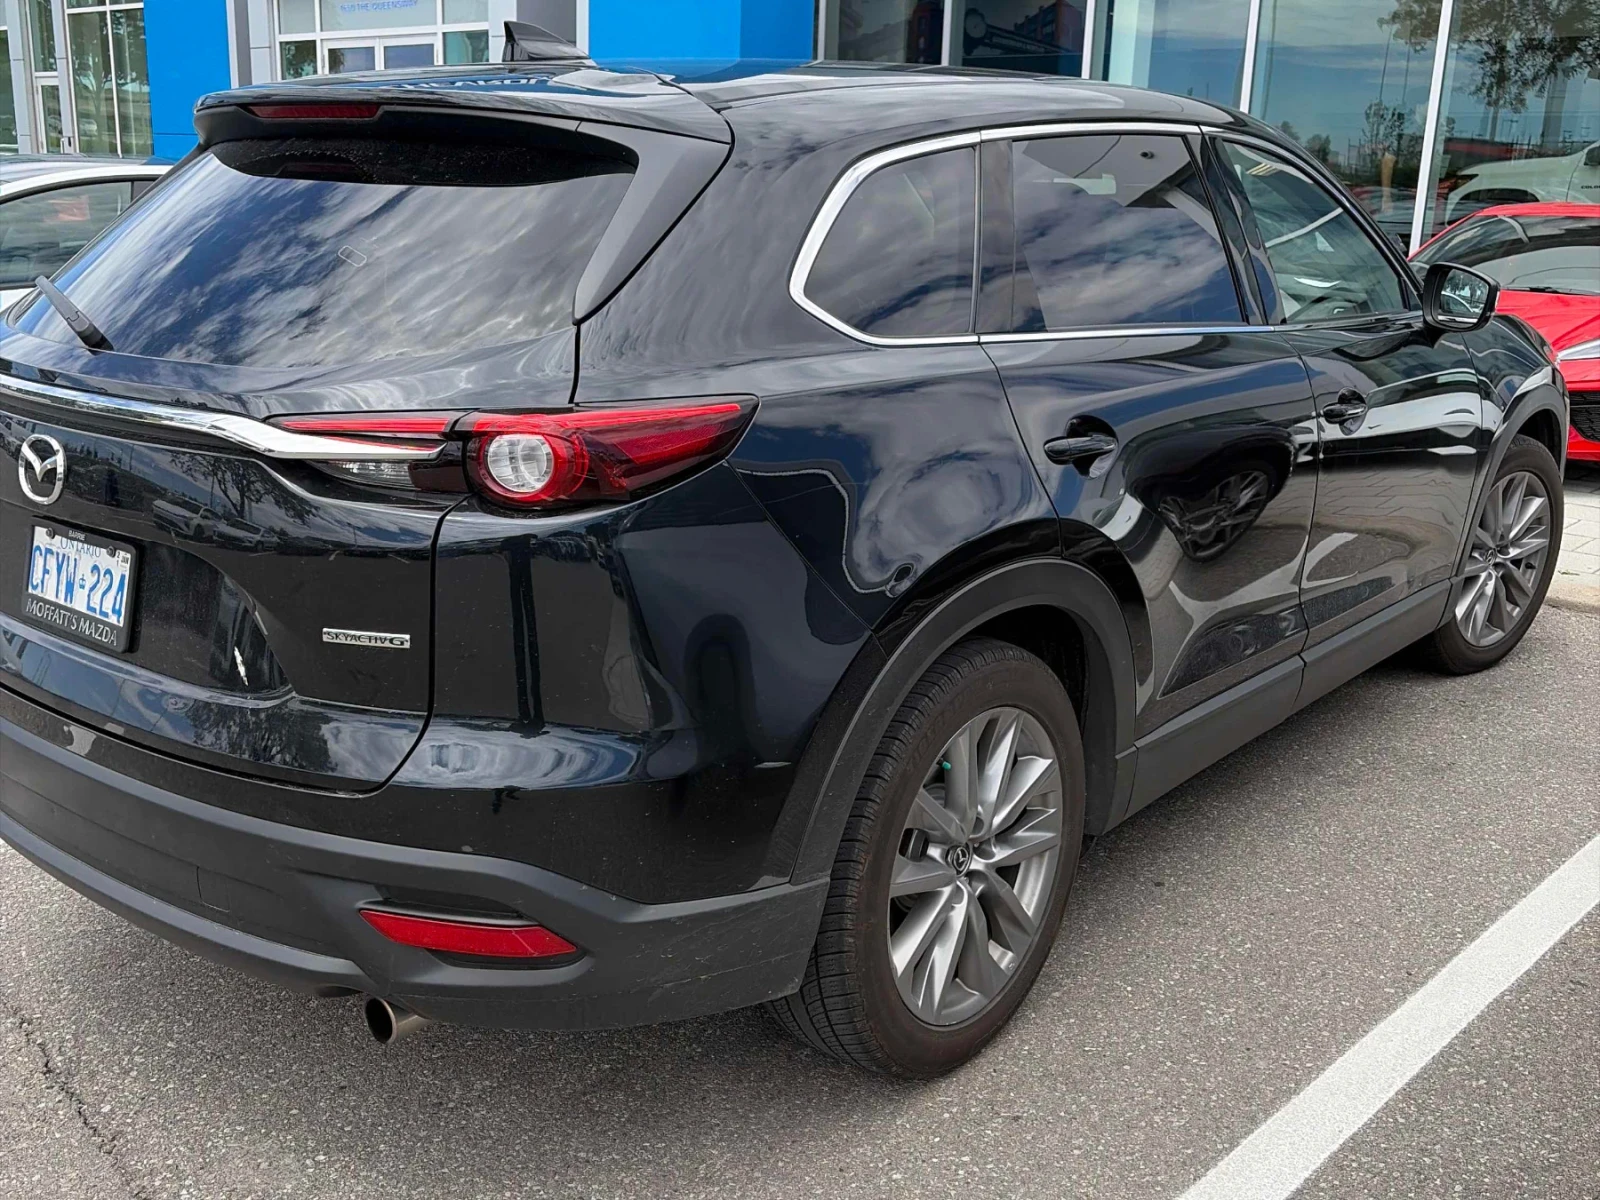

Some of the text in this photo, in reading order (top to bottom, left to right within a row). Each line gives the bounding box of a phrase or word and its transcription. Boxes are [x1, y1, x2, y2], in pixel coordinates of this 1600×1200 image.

[357, 3, 370, 11] THE
[60, 537, 102, 559] ONTARIO
[30, 544, 127, 625] CFYW 224
[25, 598, 117, 647] MOFFATT'S MAZDA
